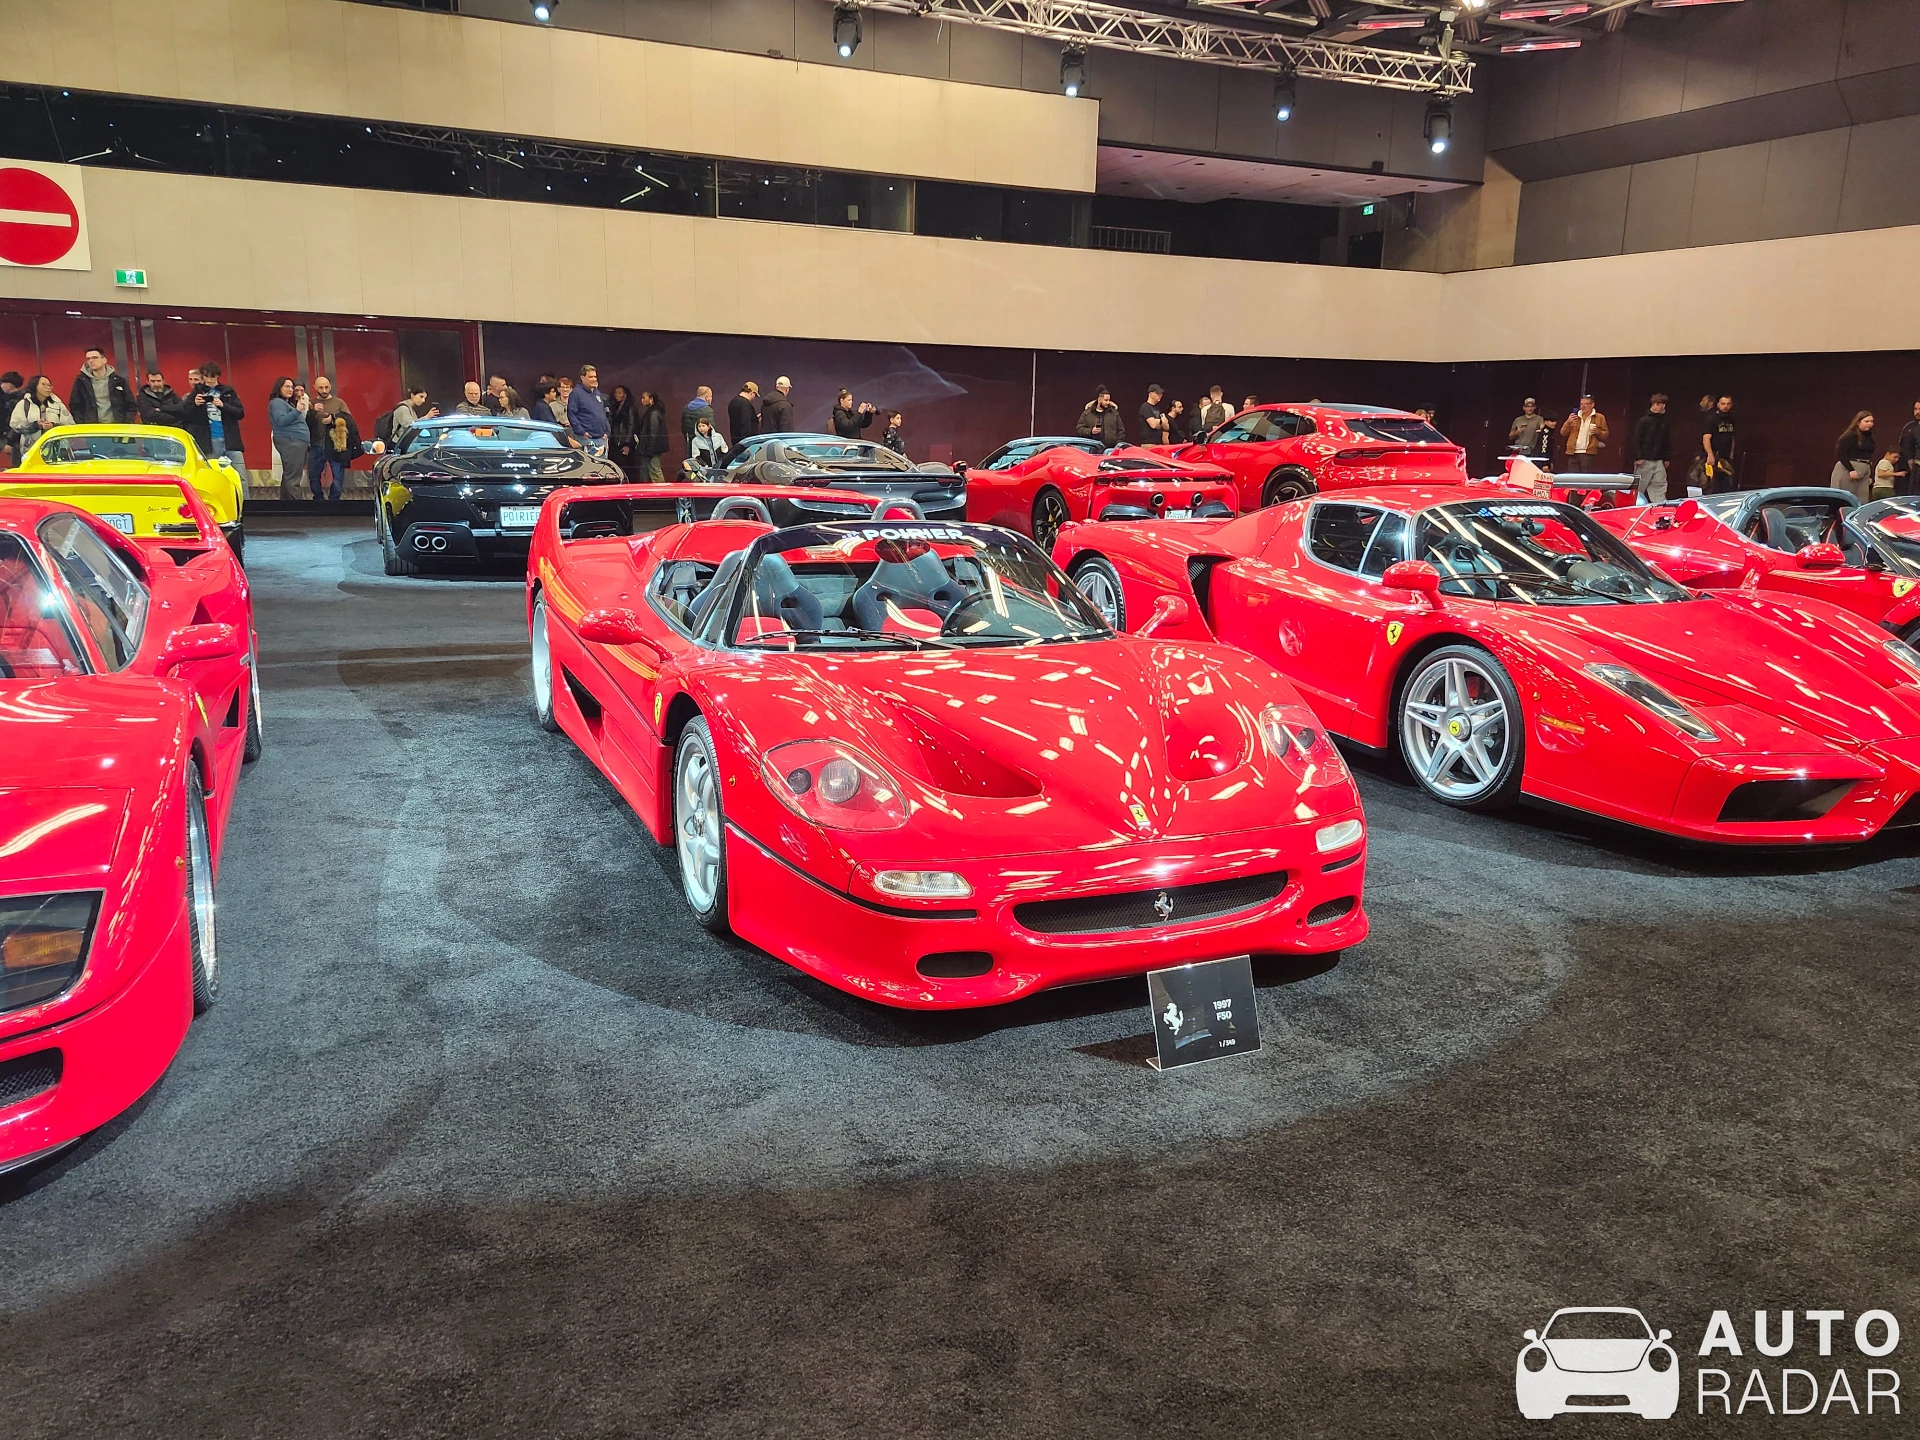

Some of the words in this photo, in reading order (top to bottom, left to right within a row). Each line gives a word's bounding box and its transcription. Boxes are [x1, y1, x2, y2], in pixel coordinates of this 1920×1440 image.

[1488, 506, 1560, 516] POIRIER
[862, 529, 963, 540] POIRIER
[1213, 999, 1232, 1011] 1997
[1216, 1011, 1233, 1021] F50
